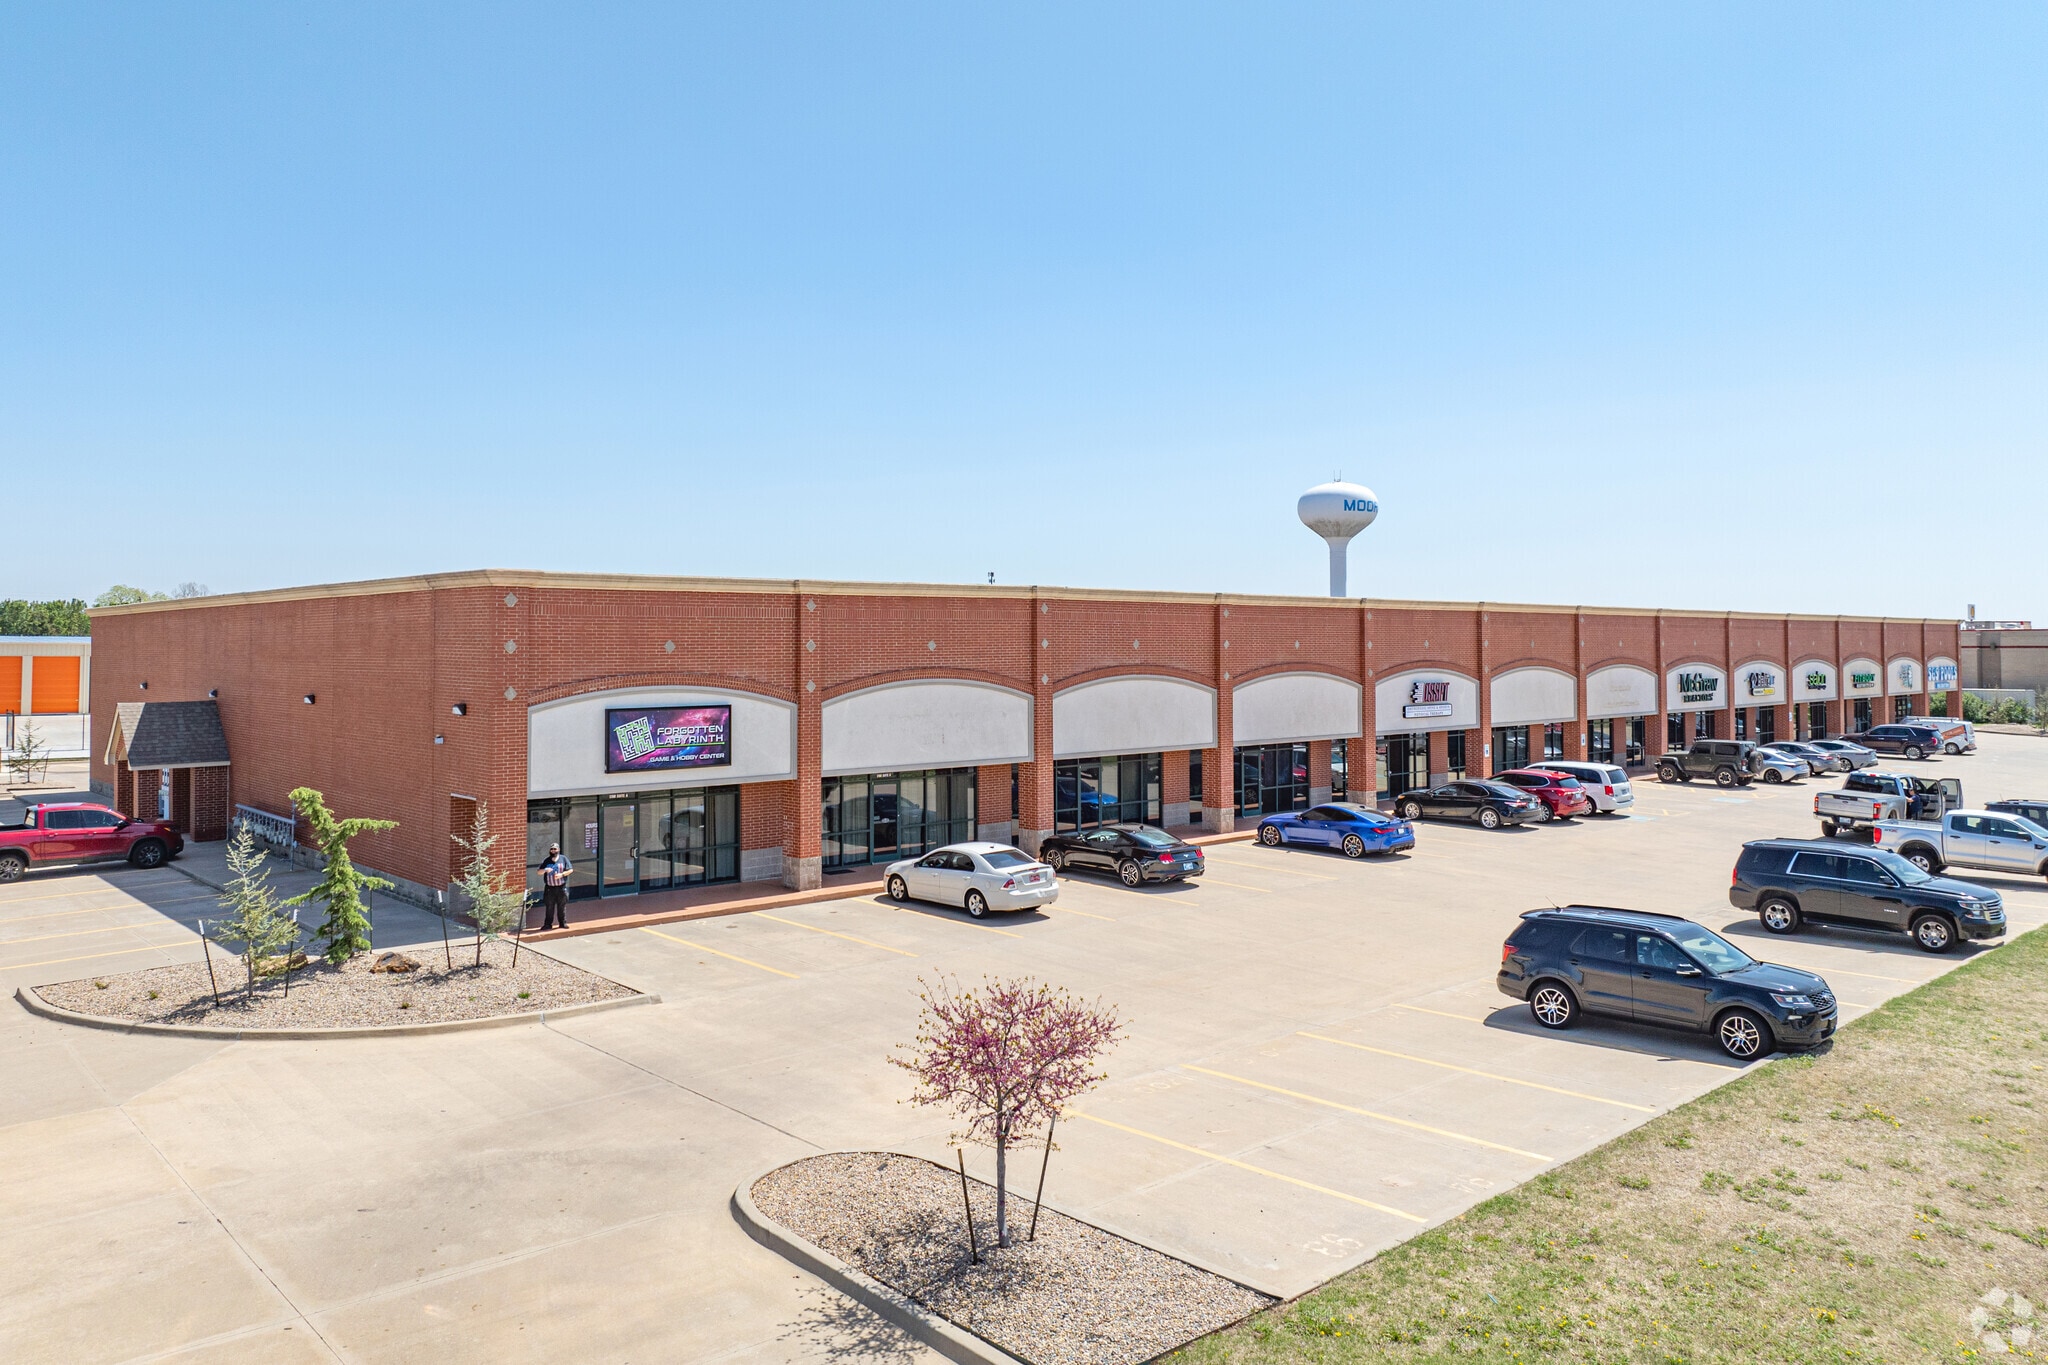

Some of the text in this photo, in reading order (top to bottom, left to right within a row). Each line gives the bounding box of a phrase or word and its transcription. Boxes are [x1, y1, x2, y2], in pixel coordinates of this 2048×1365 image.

[1679, 673, 1718, 692] McGraw
[657, 725, 723, 735] FORGOTTEN
[657, 735, 723, 745] LABYRINTH
